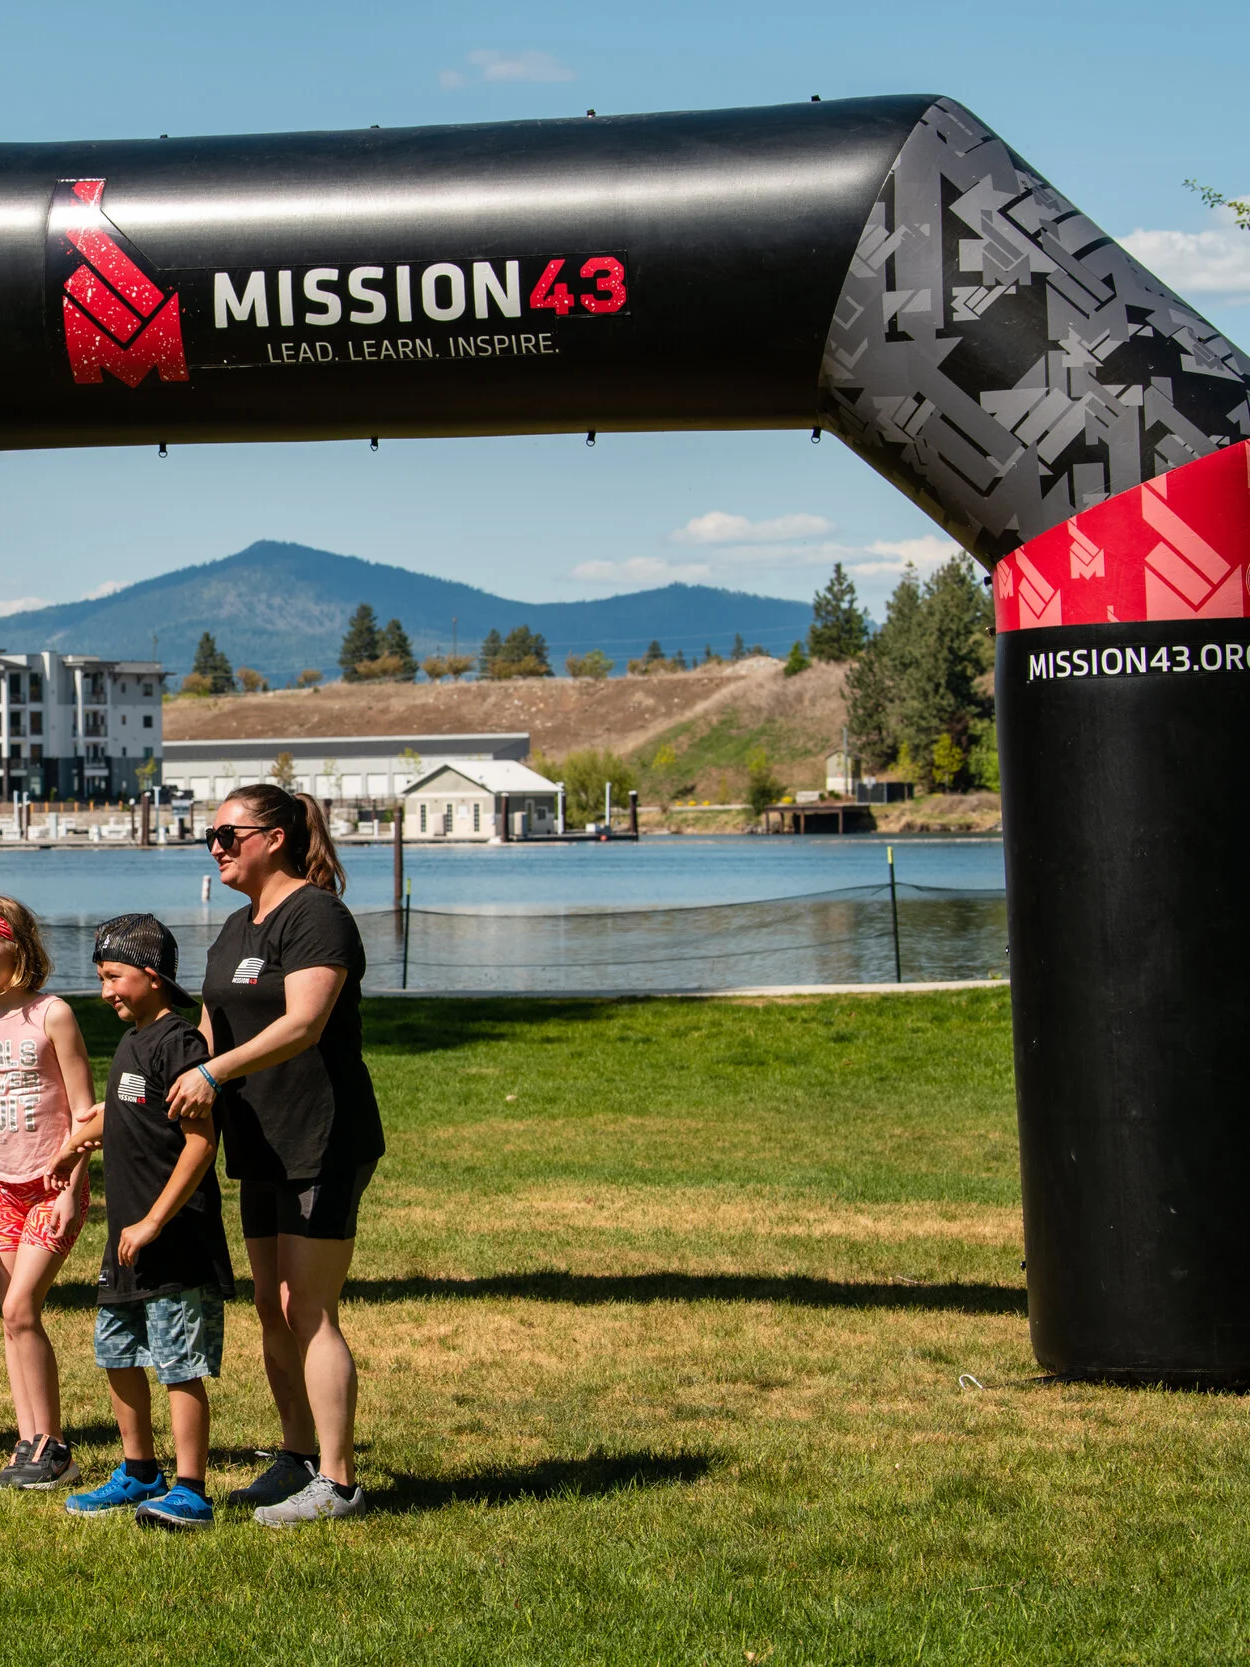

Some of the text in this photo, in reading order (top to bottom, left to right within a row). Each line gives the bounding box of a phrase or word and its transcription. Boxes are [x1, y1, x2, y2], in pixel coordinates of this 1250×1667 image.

[213, 256, 626, 329] MISSION43
[266, 332, 561, 364] LEAD. LEARN. INSPIRE.
[1028, 643, 1250, 681] MISSION43.OR
[118, 1094, 146, 1105] ISSION43
